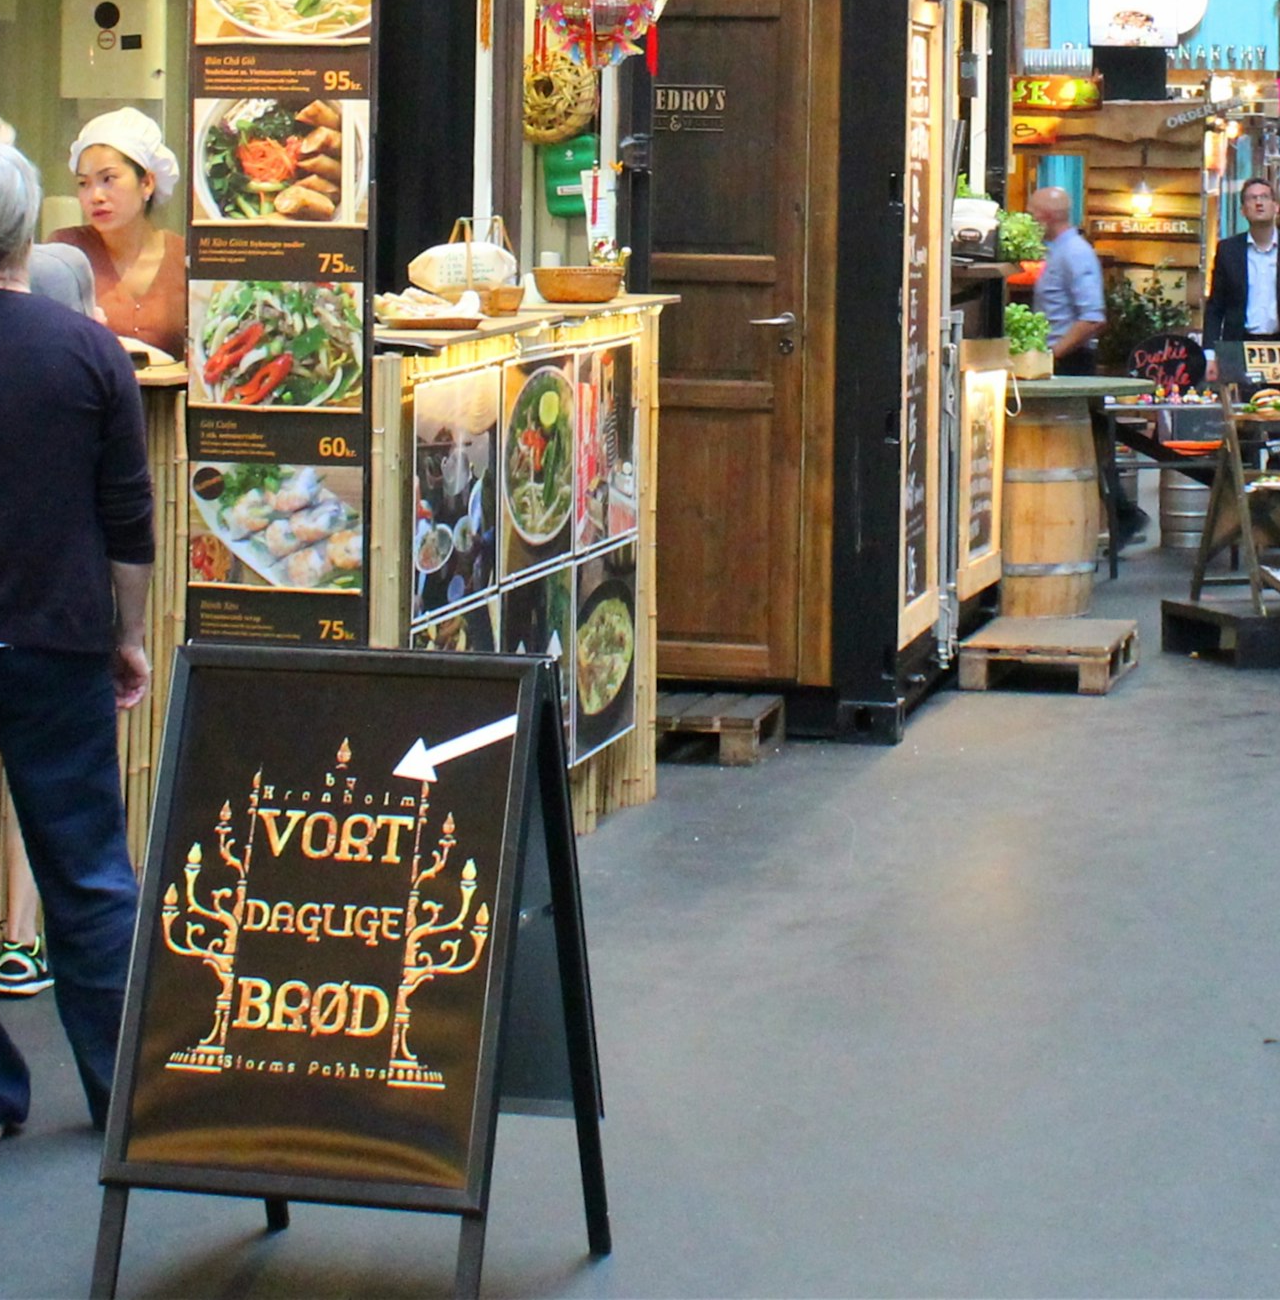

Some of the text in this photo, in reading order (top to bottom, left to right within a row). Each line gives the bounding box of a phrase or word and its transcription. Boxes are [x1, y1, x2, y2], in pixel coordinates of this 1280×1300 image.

[324, 70, 351, 90] 95
[655, 89, 726, 111] EDRO'S
[1167, 103, 1215, 128] ORDER
[318, 253, 344, 273] 75
[318, 436, 346, 457] 60
[318, 620, 344, 640] 75
[325, 773, 357, 790] by
[257, 808, 414, 864] VORT
[242, 897, 404, 948] DAGLIGE
[232, 977, 391, 1039] BRØD
